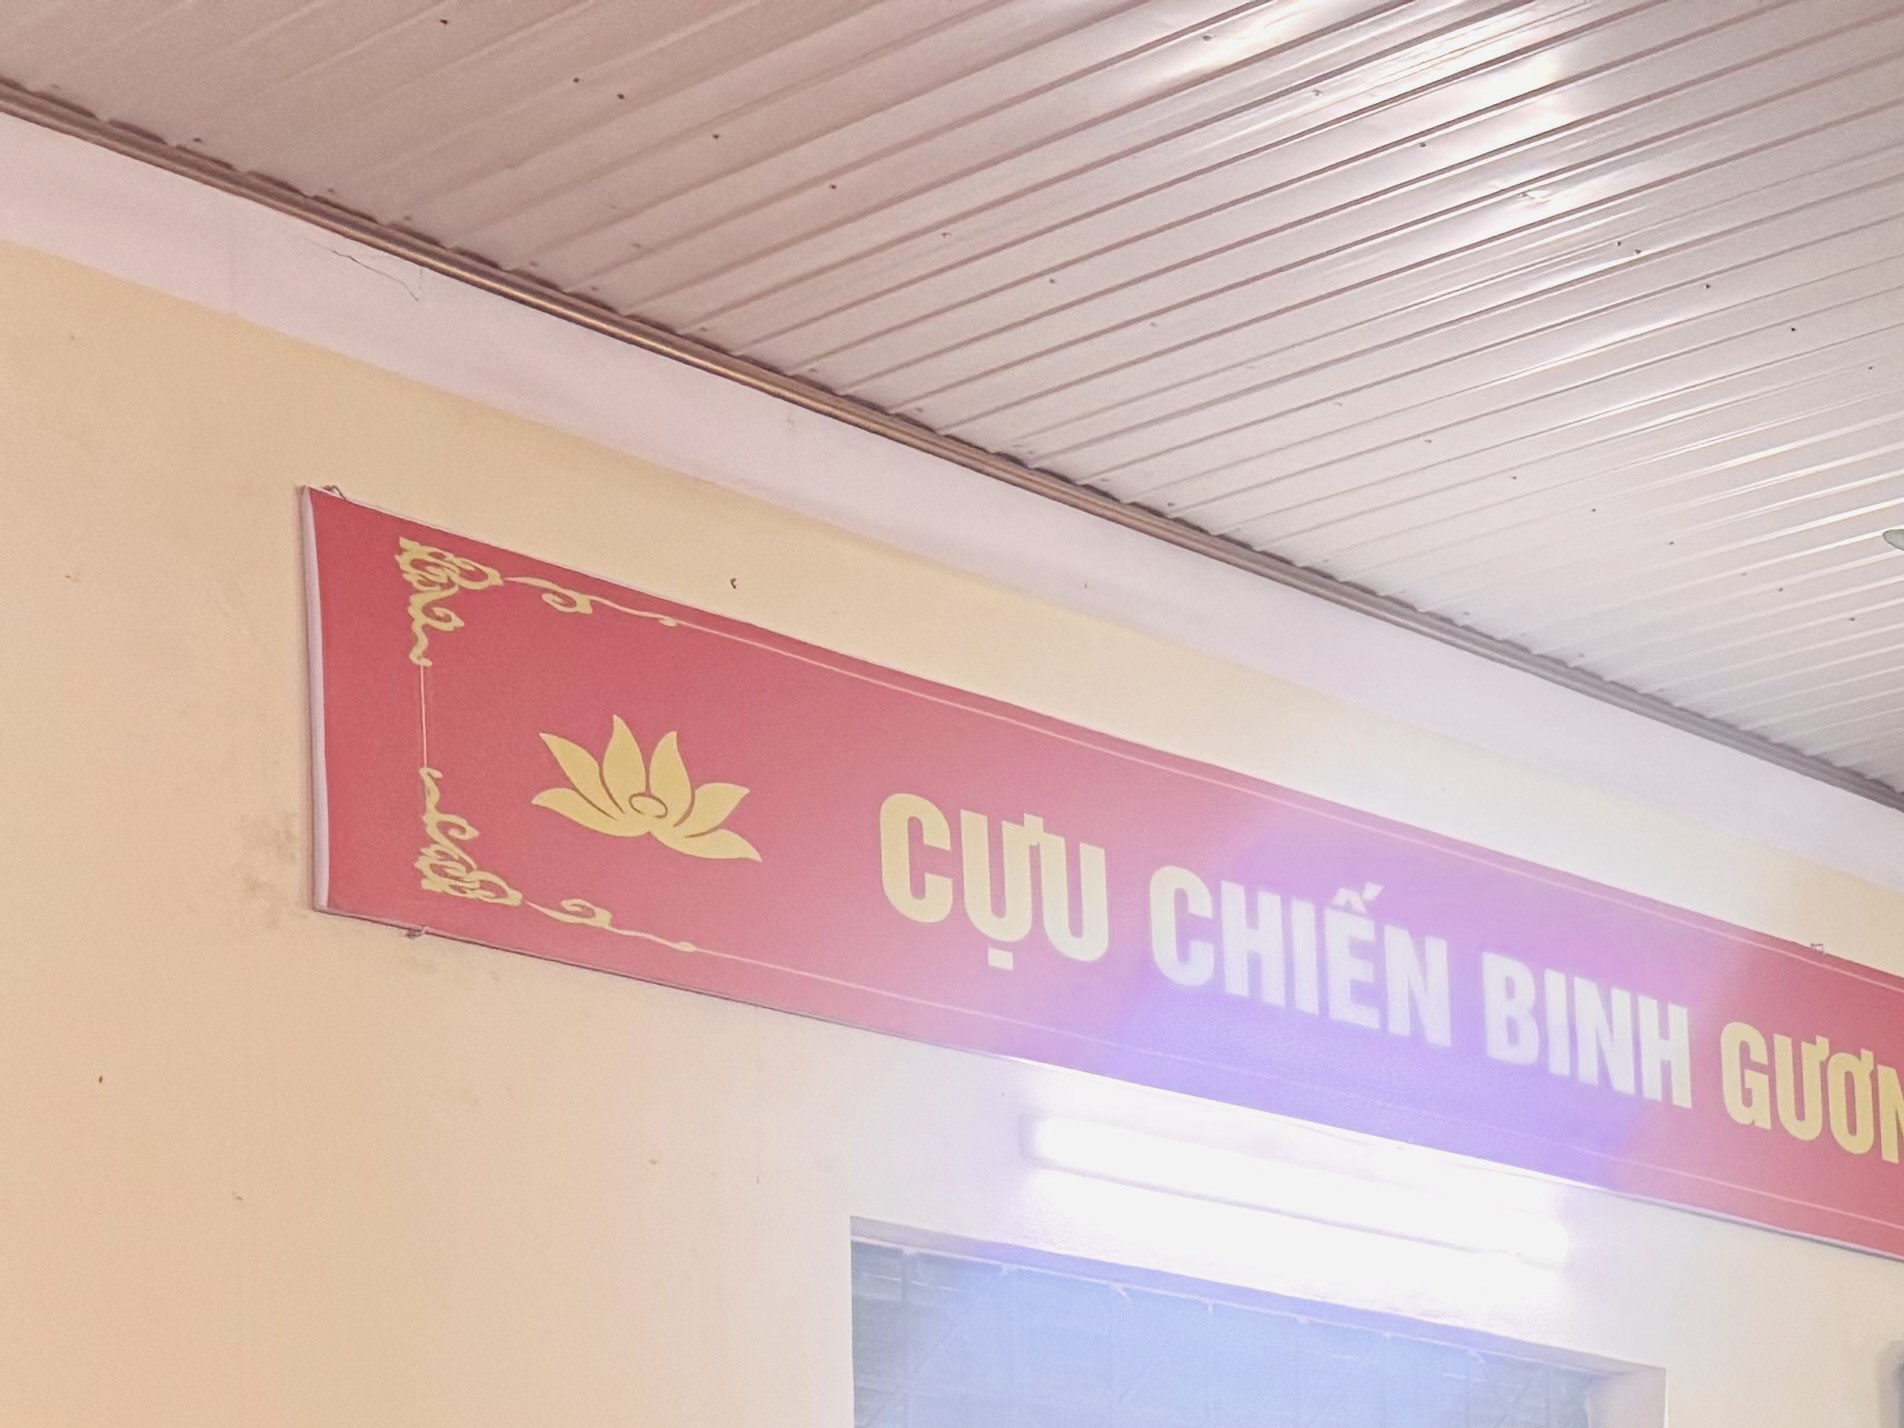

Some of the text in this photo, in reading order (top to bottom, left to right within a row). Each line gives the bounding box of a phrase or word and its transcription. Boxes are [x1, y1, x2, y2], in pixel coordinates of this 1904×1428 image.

[879, 793, 1110, 972] CỰU
[1149, 865, 1452, 1049] CHIẾN
[1481, 949, 1693, 1110] BINH
